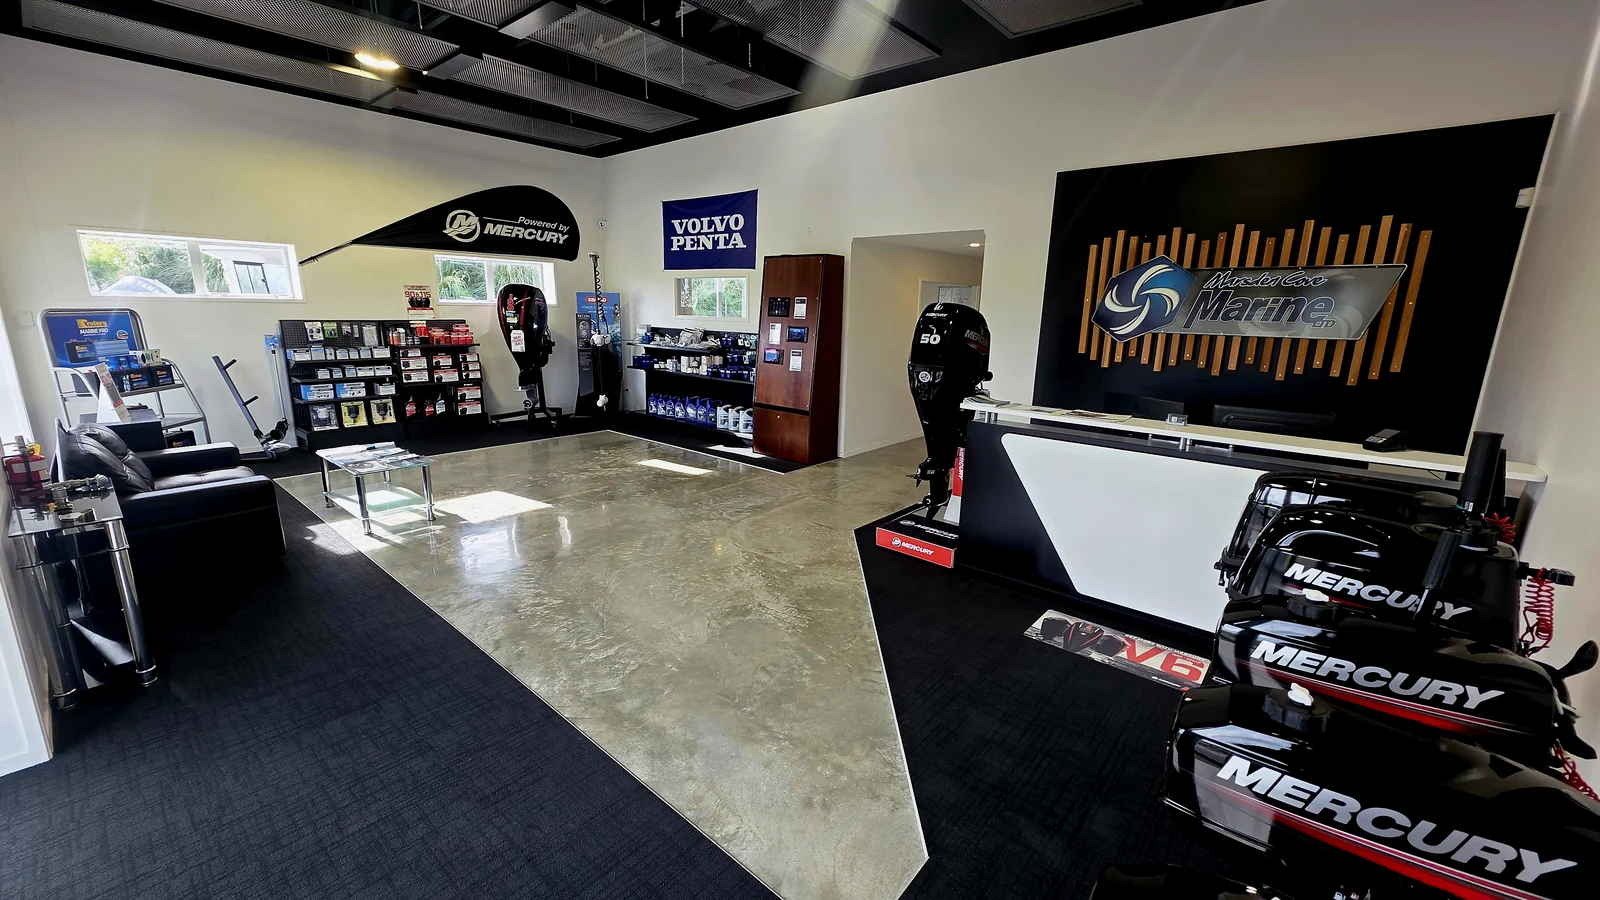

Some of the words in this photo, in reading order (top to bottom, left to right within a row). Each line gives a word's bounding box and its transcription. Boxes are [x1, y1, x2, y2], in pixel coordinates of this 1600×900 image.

[483, 222, 570, 245] MERCURY
[517, 216, 557, 229] Powered
[558, 219, 570, 234] by
[671, 213, 745, 235] VOLVO
[670, 232, 747, 251] PENTA
[1203, 270, 1282, 289] Marsden
[1281, 270, 1328, 287] Cove
[1181, 289, 1335, 330] Marine
[920, 333, 941, 345] 50
[901, 541, 934, 556] MERCURY
[1124, 637, 1205, 682] V6
[1250, 639, 1505, 710] MERCURY
[1217, 755, 1578, 884] MERCURY
